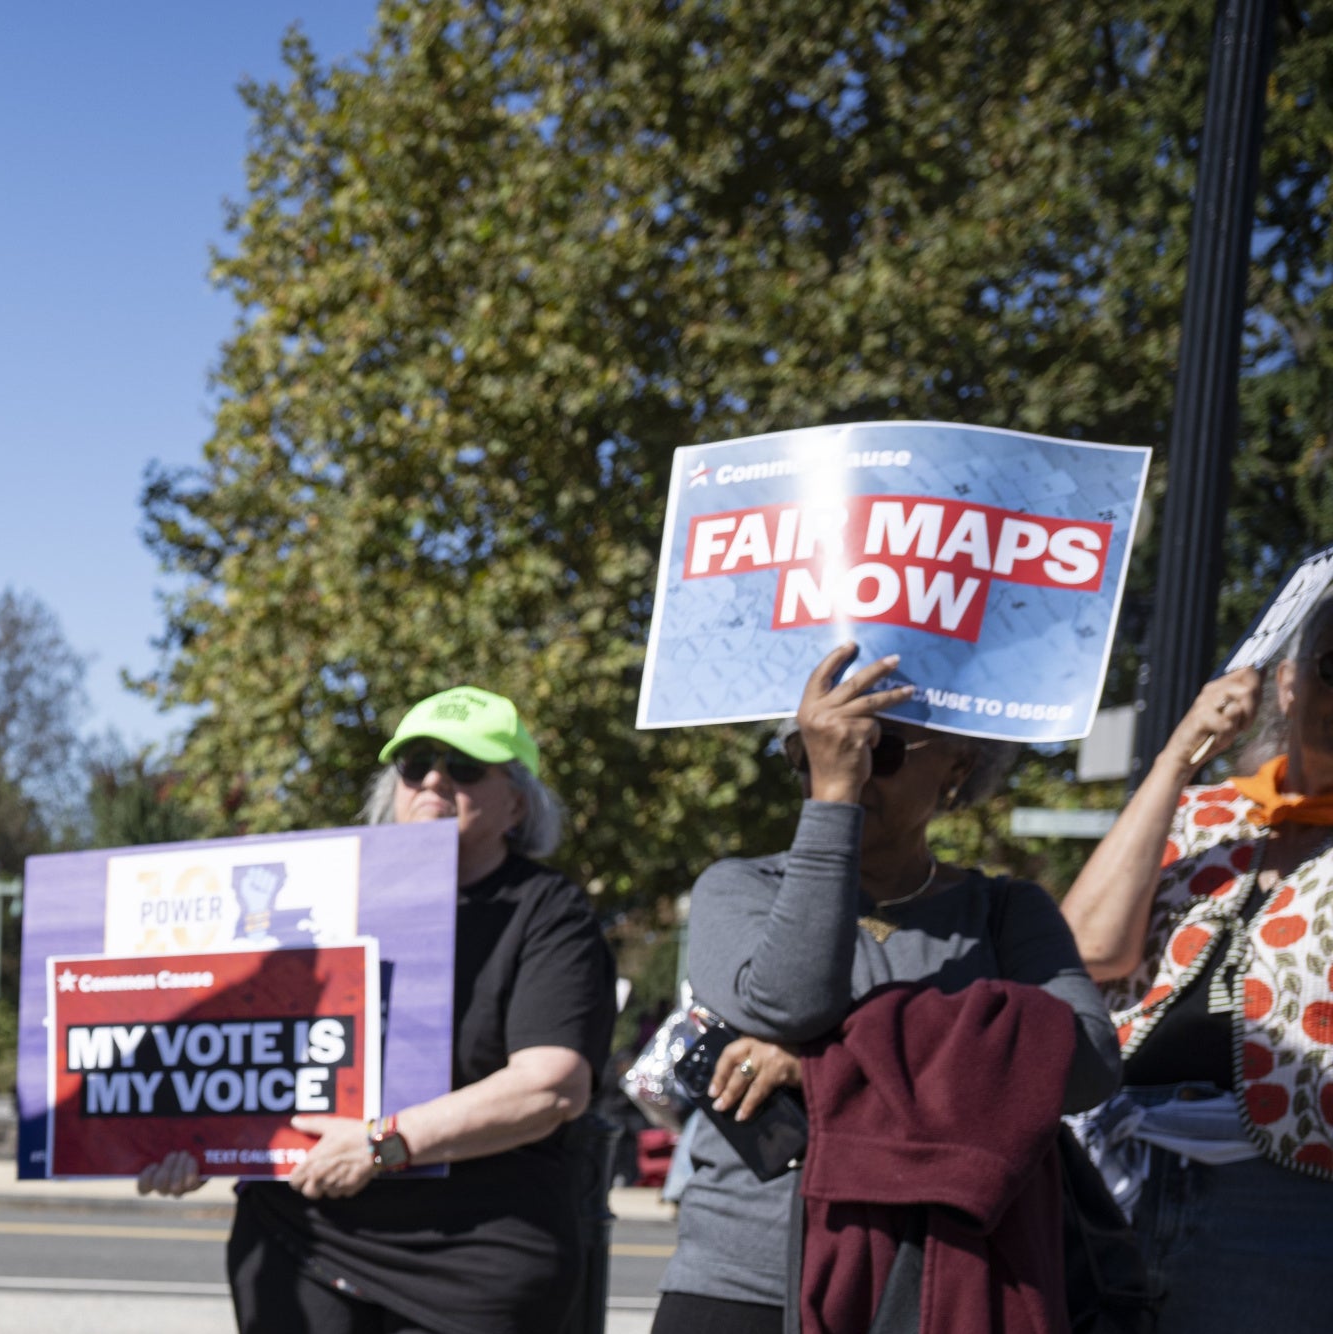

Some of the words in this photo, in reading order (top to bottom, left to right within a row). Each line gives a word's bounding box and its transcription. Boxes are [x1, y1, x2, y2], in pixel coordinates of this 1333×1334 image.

[864, 502, 1102, 586] MAPS
[779, 562, 981, 631] NOW
[975, 697, 1003, 716] TO
[140, 896, 223, 925] POWER
[78, 971, 155, 993] Common
[156, 969, 215, 989] Cause
[68, 1025, 146, 1070] MY
[152, 1021, 283, 1067] VOTE
[294, 1018, 345, 1064] IS
[87, 1071, 163, 1114] MY
[169, 1067, 330, 1113] VOICE
